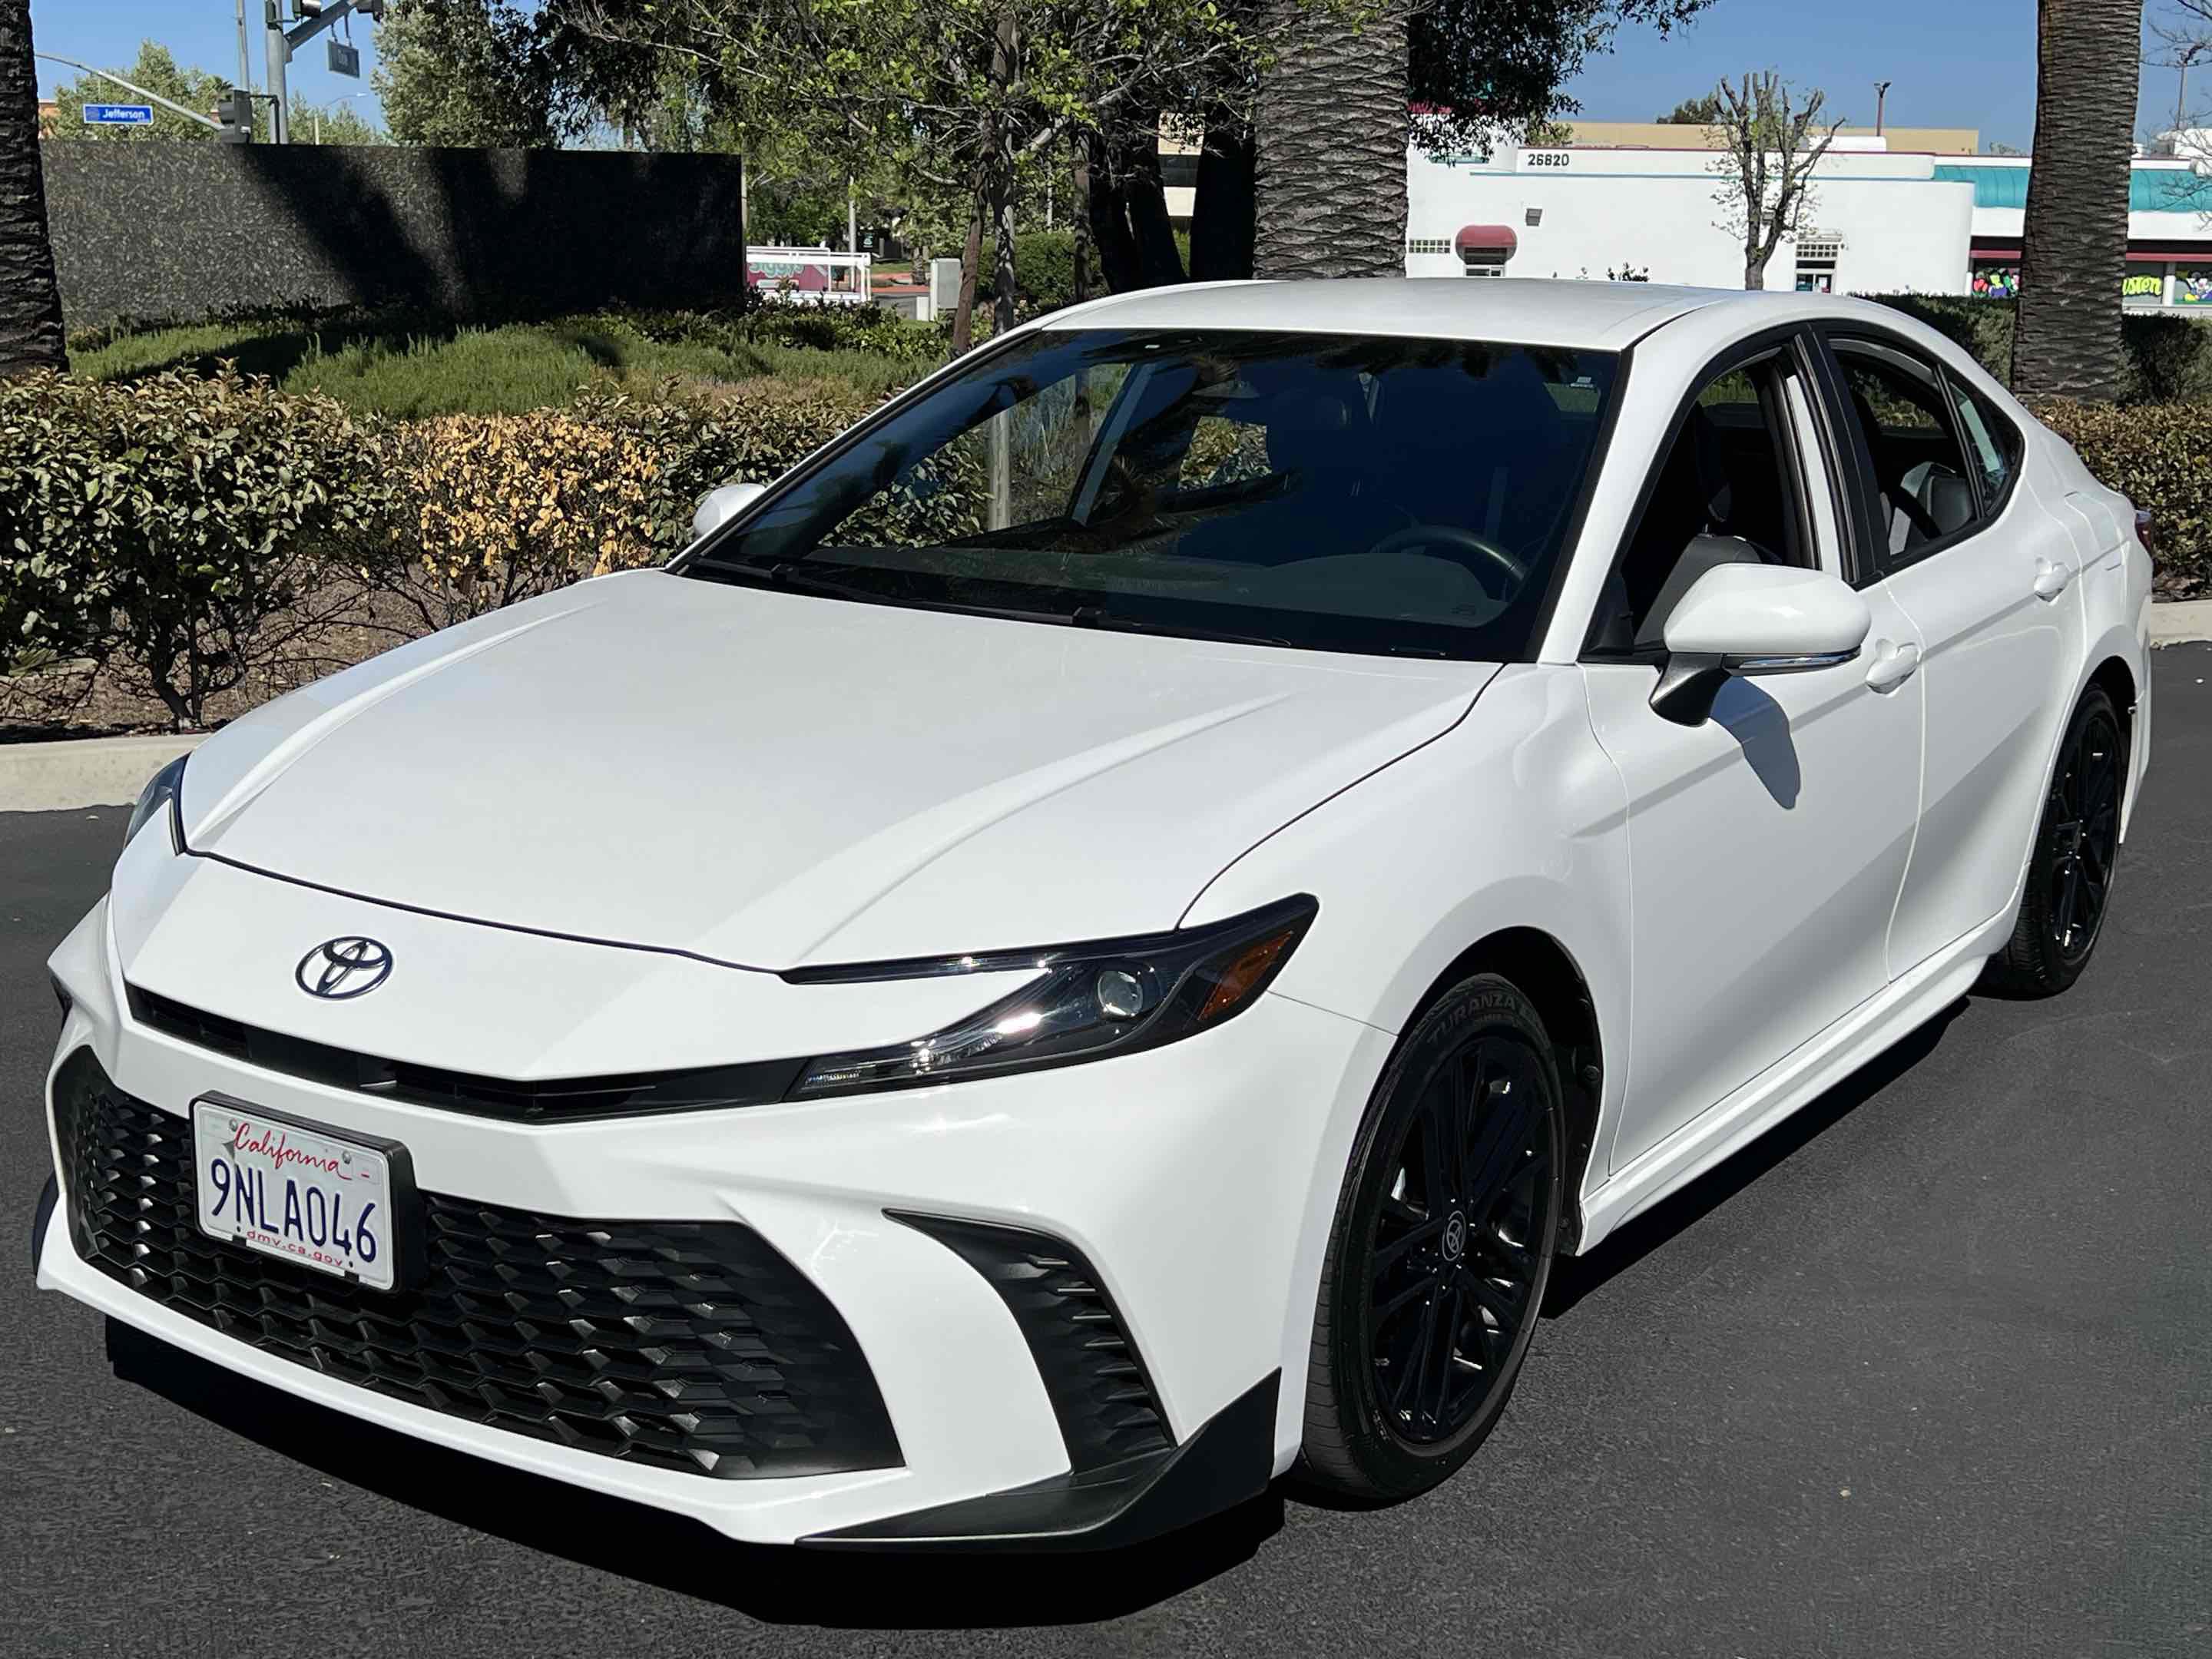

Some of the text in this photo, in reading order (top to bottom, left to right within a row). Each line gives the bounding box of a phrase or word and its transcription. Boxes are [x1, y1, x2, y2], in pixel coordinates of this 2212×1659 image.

[102, 108, 146, 119] Jefferson
[1528, 153, 1570, 167] 26820
[1426, 993, 1517, 1044] TURANZA
[233, 1122, 353, 1181] California
[210, 1157, 376, 1263] 9NLA046
[246, 1229, 343, 1267] dmv.ca.gov
